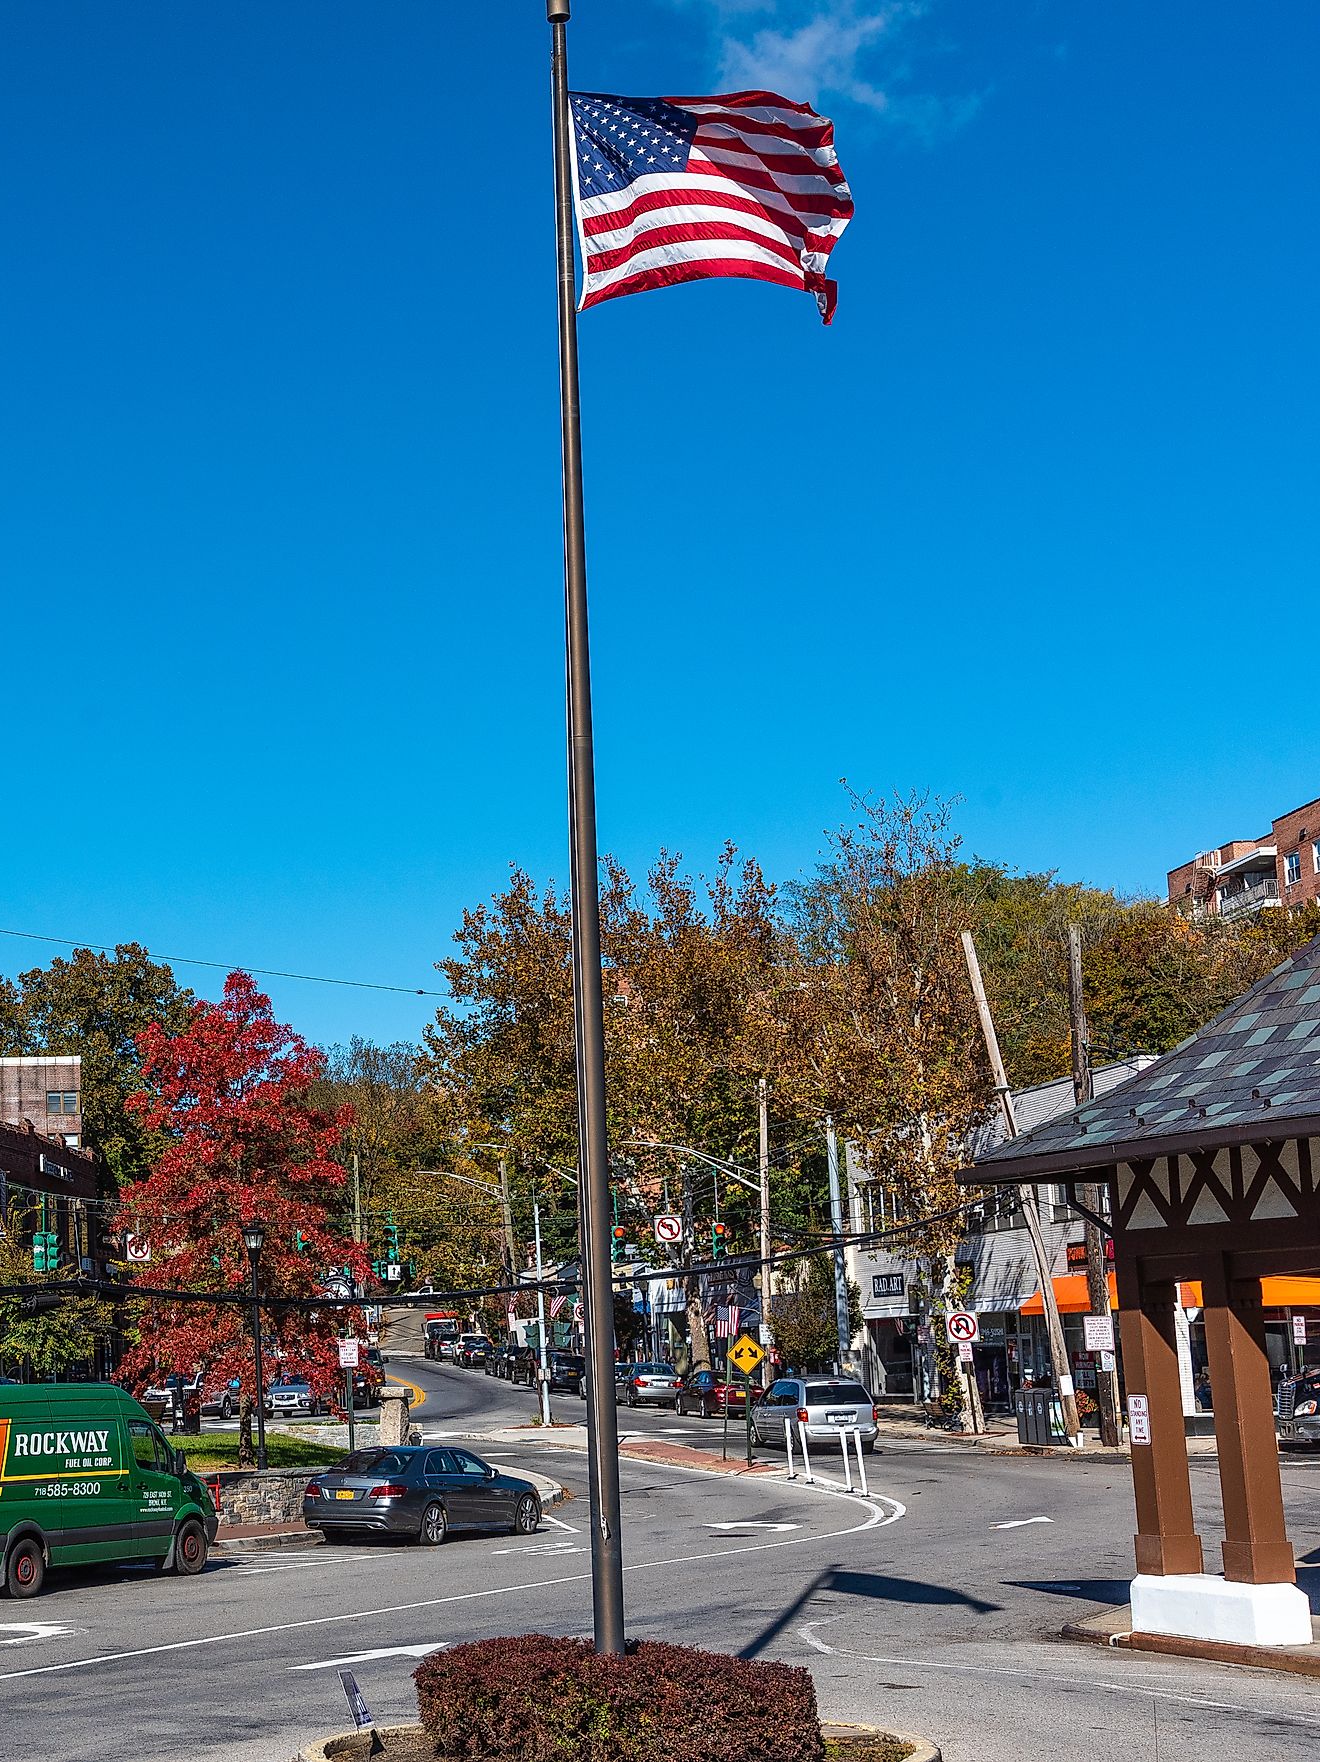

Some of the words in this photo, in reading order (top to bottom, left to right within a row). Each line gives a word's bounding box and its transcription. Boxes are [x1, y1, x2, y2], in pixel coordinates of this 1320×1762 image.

[1133, 1399, 1141, 1409] NO
[14, 1430, 109, 1456] ROCKWAY
[65, 1458, 81, 1468] FUEL
[82, 1458, 93, 1467] OIL
[94, 1457, 113, 1467] CORP.
[34, 1487, 47, 1496] 718
[47, 1482, 101, 1497] 585-8300
